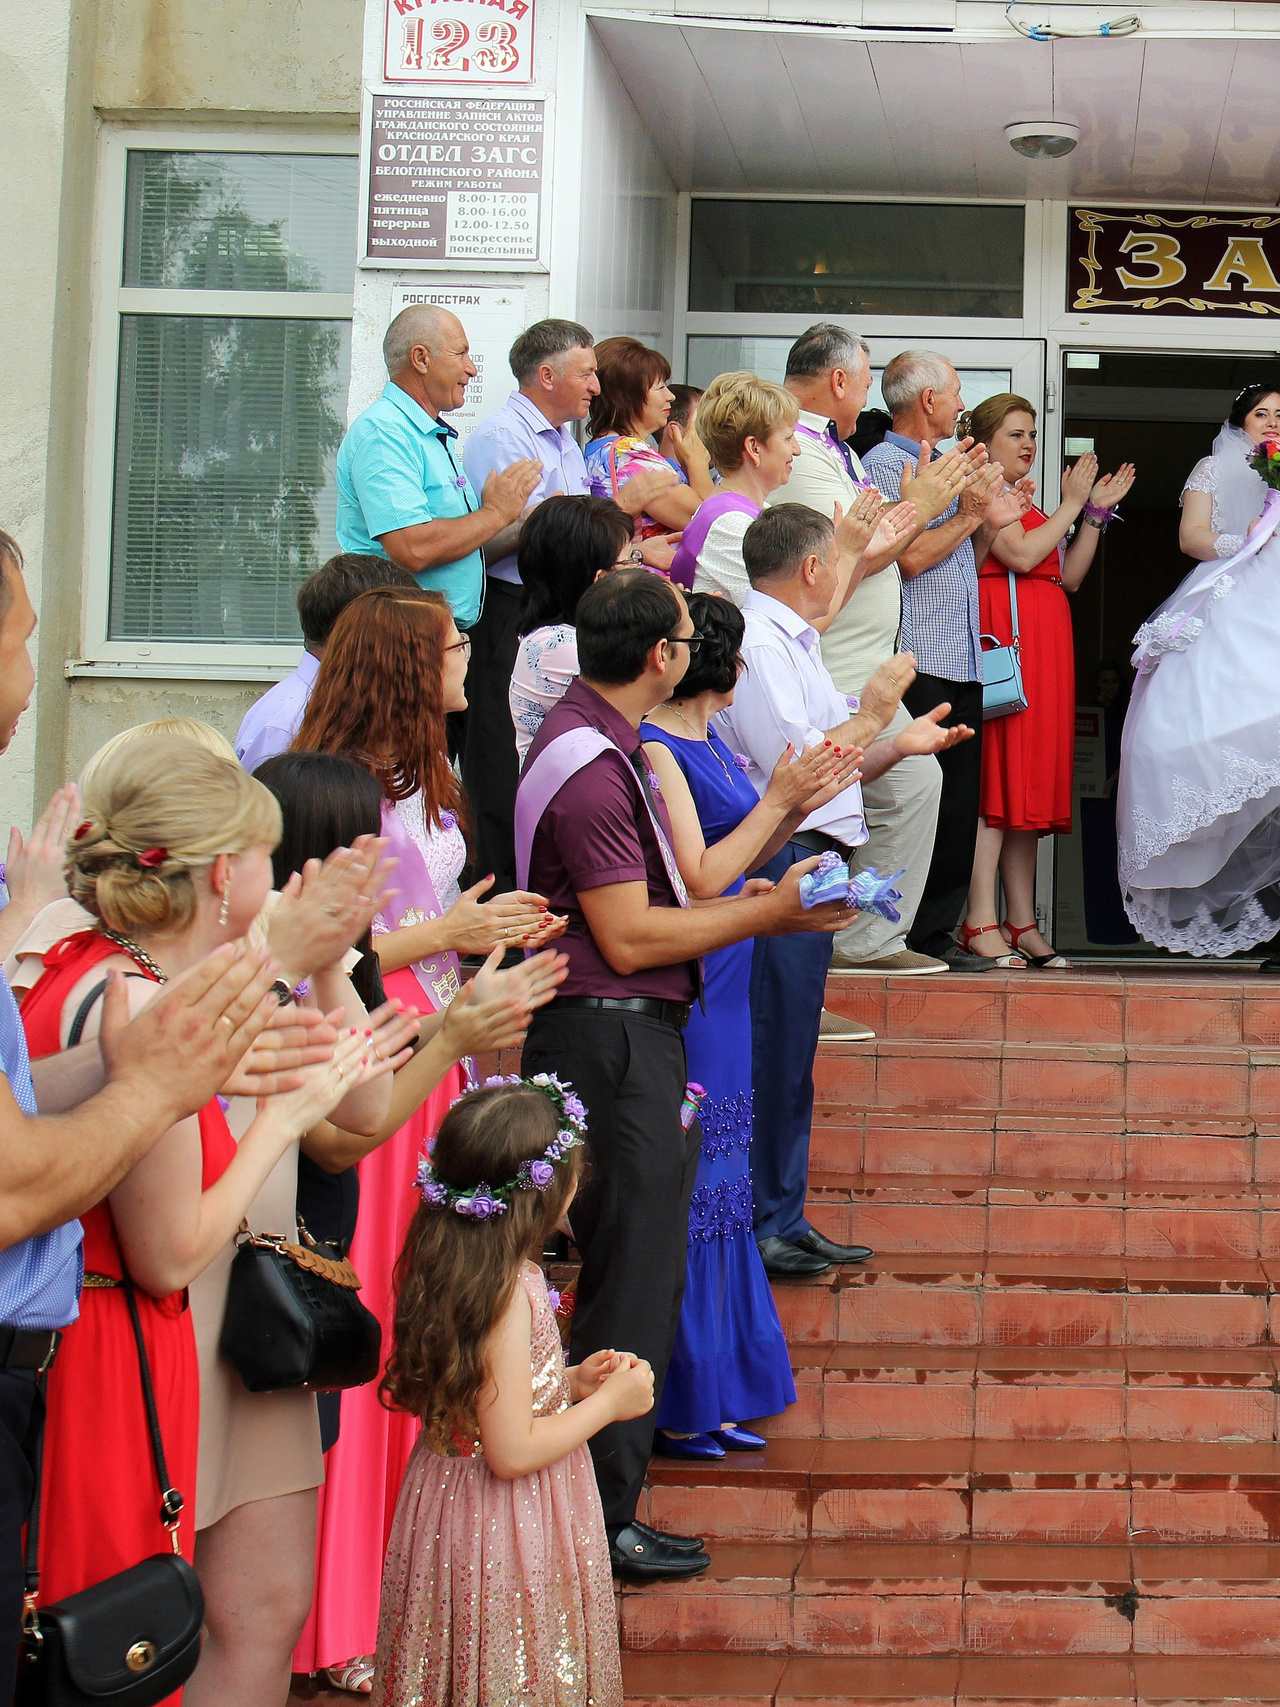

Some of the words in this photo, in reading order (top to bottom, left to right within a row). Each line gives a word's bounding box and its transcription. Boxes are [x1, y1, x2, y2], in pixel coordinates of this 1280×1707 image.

[400, 17, 519, 73] 123
[384, 98, 461, 110] РОССИЙСКАЯ
[465, 101, 536, 112] ФЕДЕРАЦИЯ
[376, 110, 451, 120] УПРАВЛЕНИЕ
[455, 112, 501, 121] ЗАПИСИ
[506, 113, 543, 122] АКТОВ
[375, 120, 469, 131] ГРАЖДАНСКОГО
[474, 123, 543, 133] СОСТОЯНИЯ
[387, 131, 494, 142] КРАСНОДАРСКОГО
[498, 134, 530, 143] КРАЯ
[378, 144, 462, 165] ОТДЕЛ
[470, 146, 538, 164] ЗАГС
[375, 166, 482, 178] БЕЛОГЛИНСКОГО
[487, 168, 540, 179] РАЙОНА
[411, 179, 453, 189] РЕЖИМ
[457, 180, 503, 190] РАБОТЫ
[374, 193, 446, 204] ежедневно
[458, 193, 527, 204] 8.00-17.00
[373, 206, 429, 217] пятница
[458, 207, 527, 217] 8.00-16.00
[373, 219, 431, 230] перерыв
[454, 220, 530, 230] 12.00-12.50
[371, 237, 438, 249] выходной
[450, 234, 533, 244] воскресенье
[449, 245, 534, 255] понедельник
[402, 294, 480, 305] РОСГОССТРАХ
